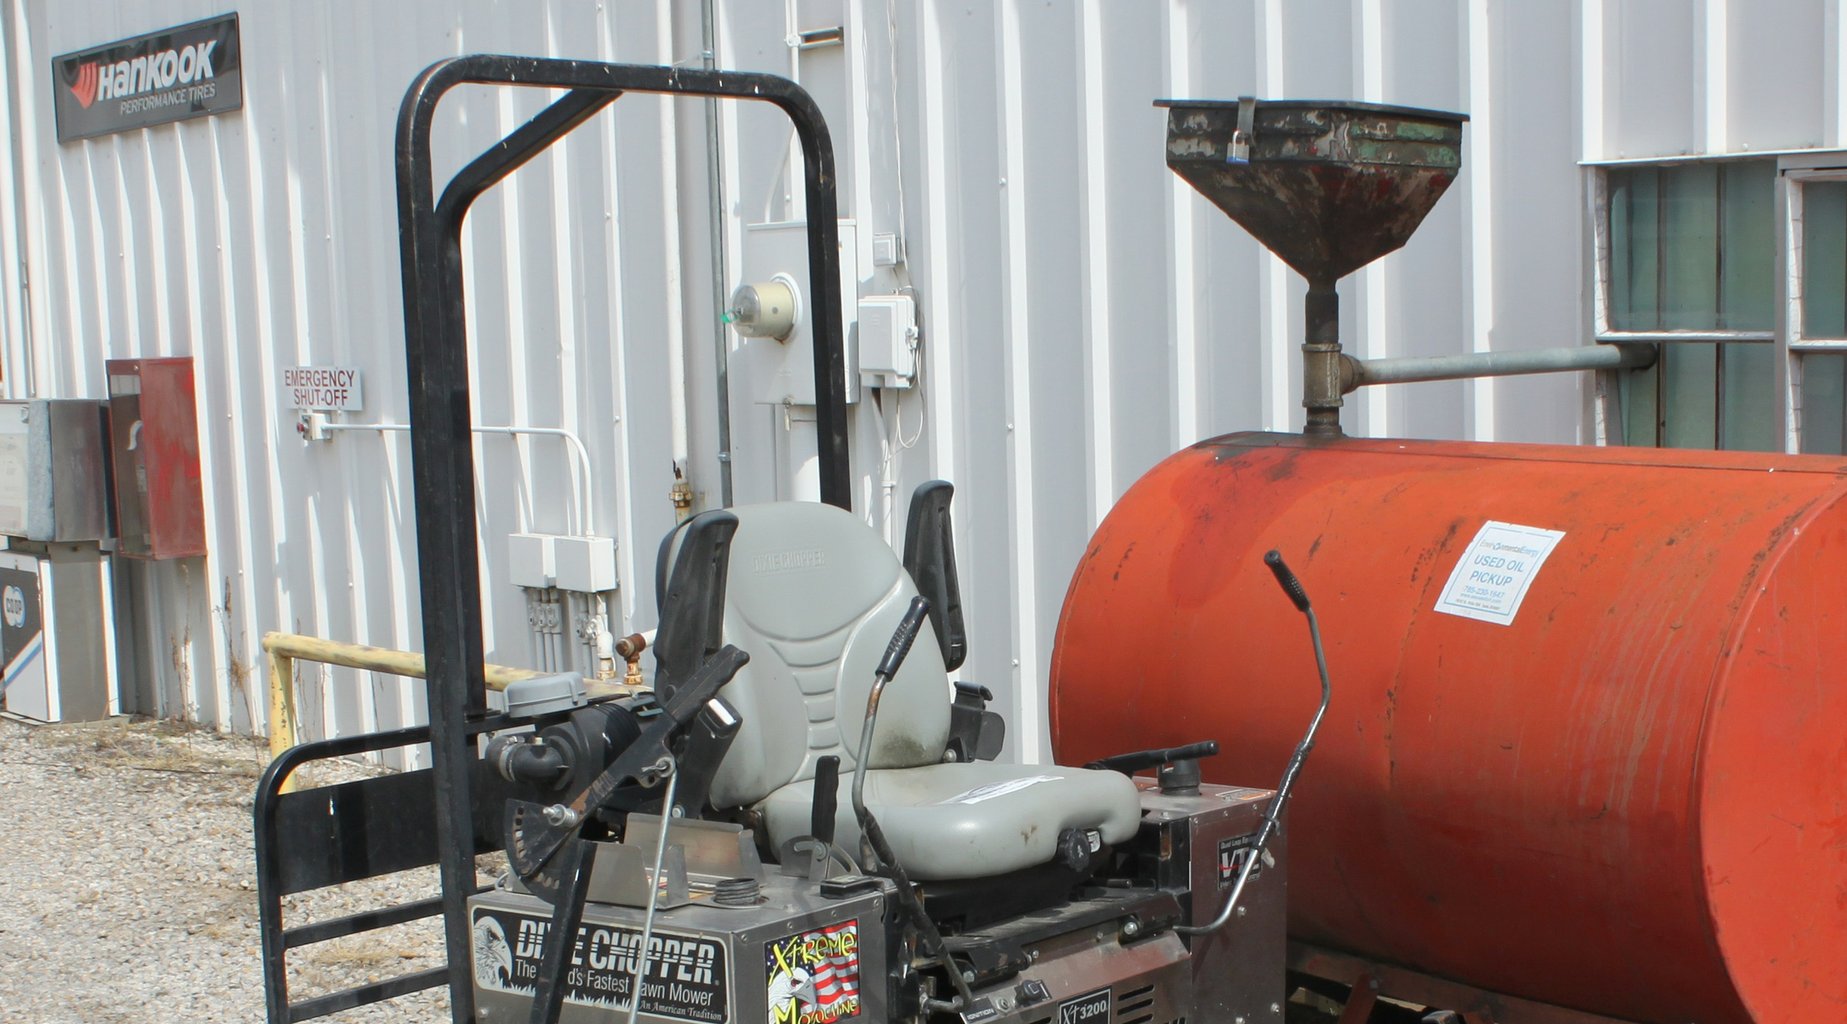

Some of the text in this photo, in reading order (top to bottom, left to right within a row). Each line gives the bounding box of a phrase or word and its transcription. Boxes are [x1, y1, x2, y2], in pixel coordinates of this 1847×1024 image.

[120, 83, 216, 115] PERFORMANCE TIRES
[284, 369, 355, 387] EMERGENCY
[294, 388, 348, 406] SHUT-OFF
[1474, 554, 1525, 573] USED OIL
[1469, 570, 1513, 586] PICKUP
[515, 919, 715, 985] DIE CHOPPER
[515, 958, 537, 978] The
[586, 970, 629, 994] Fastest
[640, 981, 666, 999] awn
[669, 982, 714, 1006] Mower
[651, 1002, 686, 1016] American
[687, 1007, 723, 1021] Tradition
[966, 1008, 995, 1022] IGNITION
[1080, 1000, 1107, 1020] 3200
